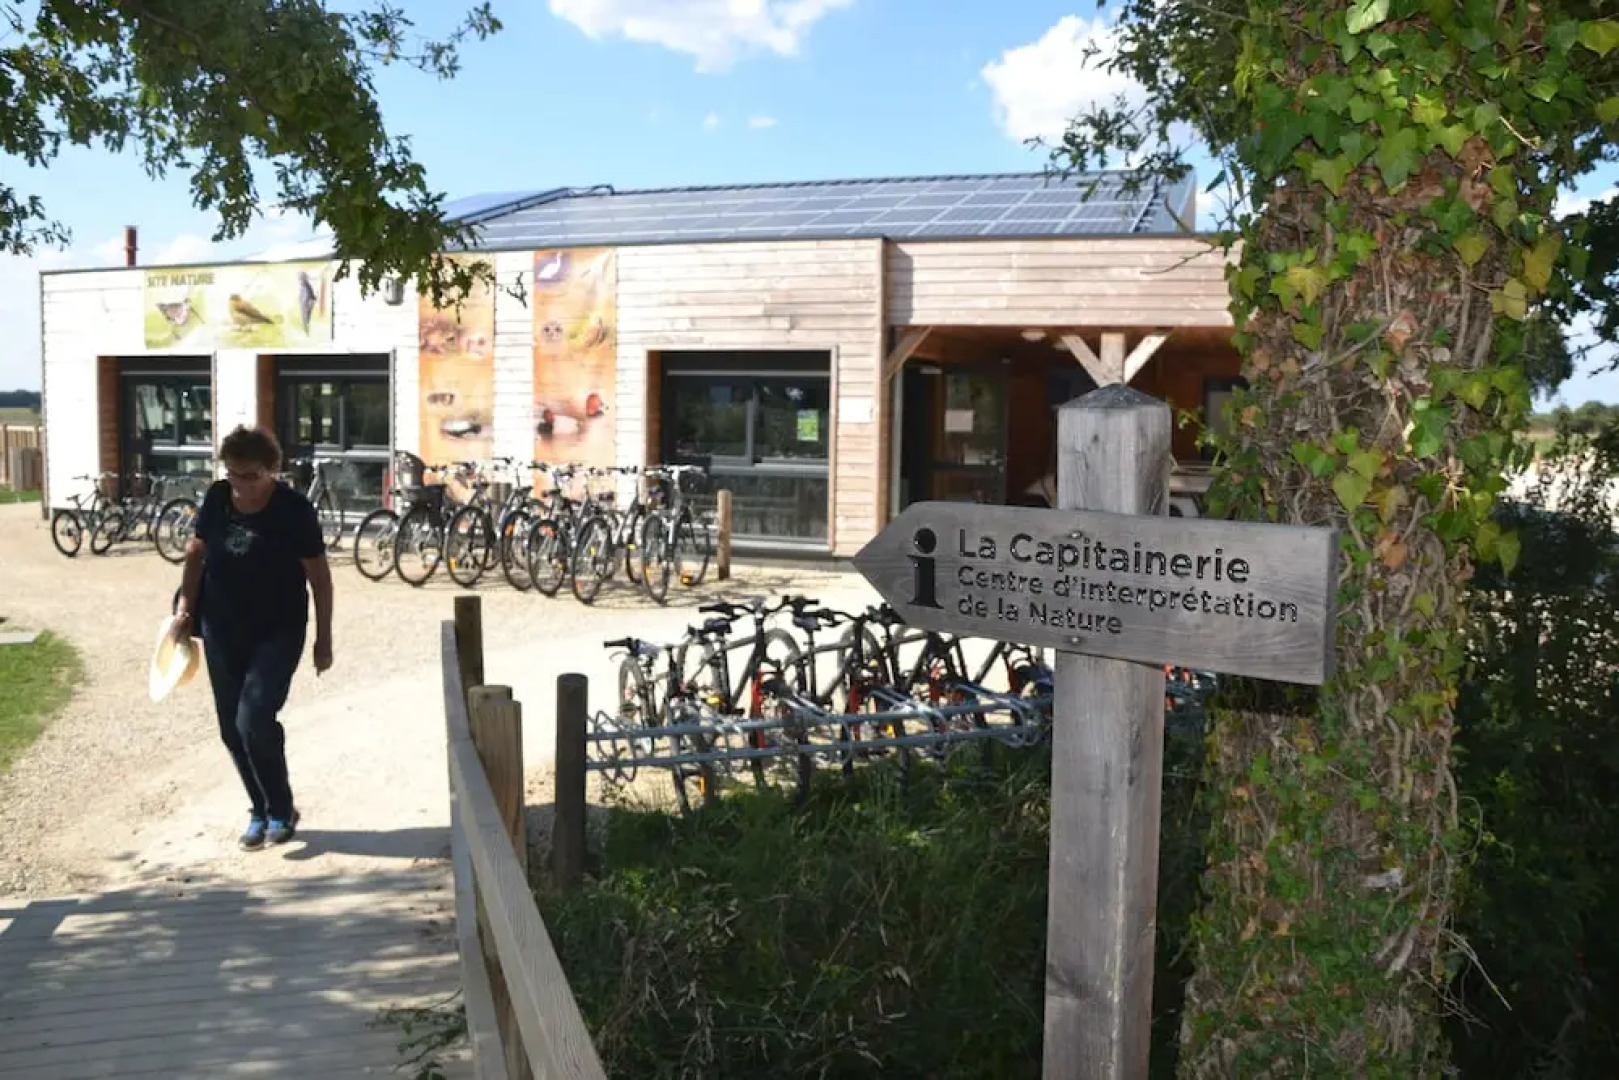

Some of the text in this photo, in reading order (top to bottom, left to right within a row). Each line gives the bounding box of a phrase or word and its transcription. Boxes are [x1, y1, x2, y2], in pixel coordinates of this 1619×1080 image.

[172, 272, 215, 285] NATURE
[958, 529, 1251, 584] La Capitainerie
[957, 566, 1299, 623] Centre d'interprétation
[957, 594, 1123, 635] de la Nature
